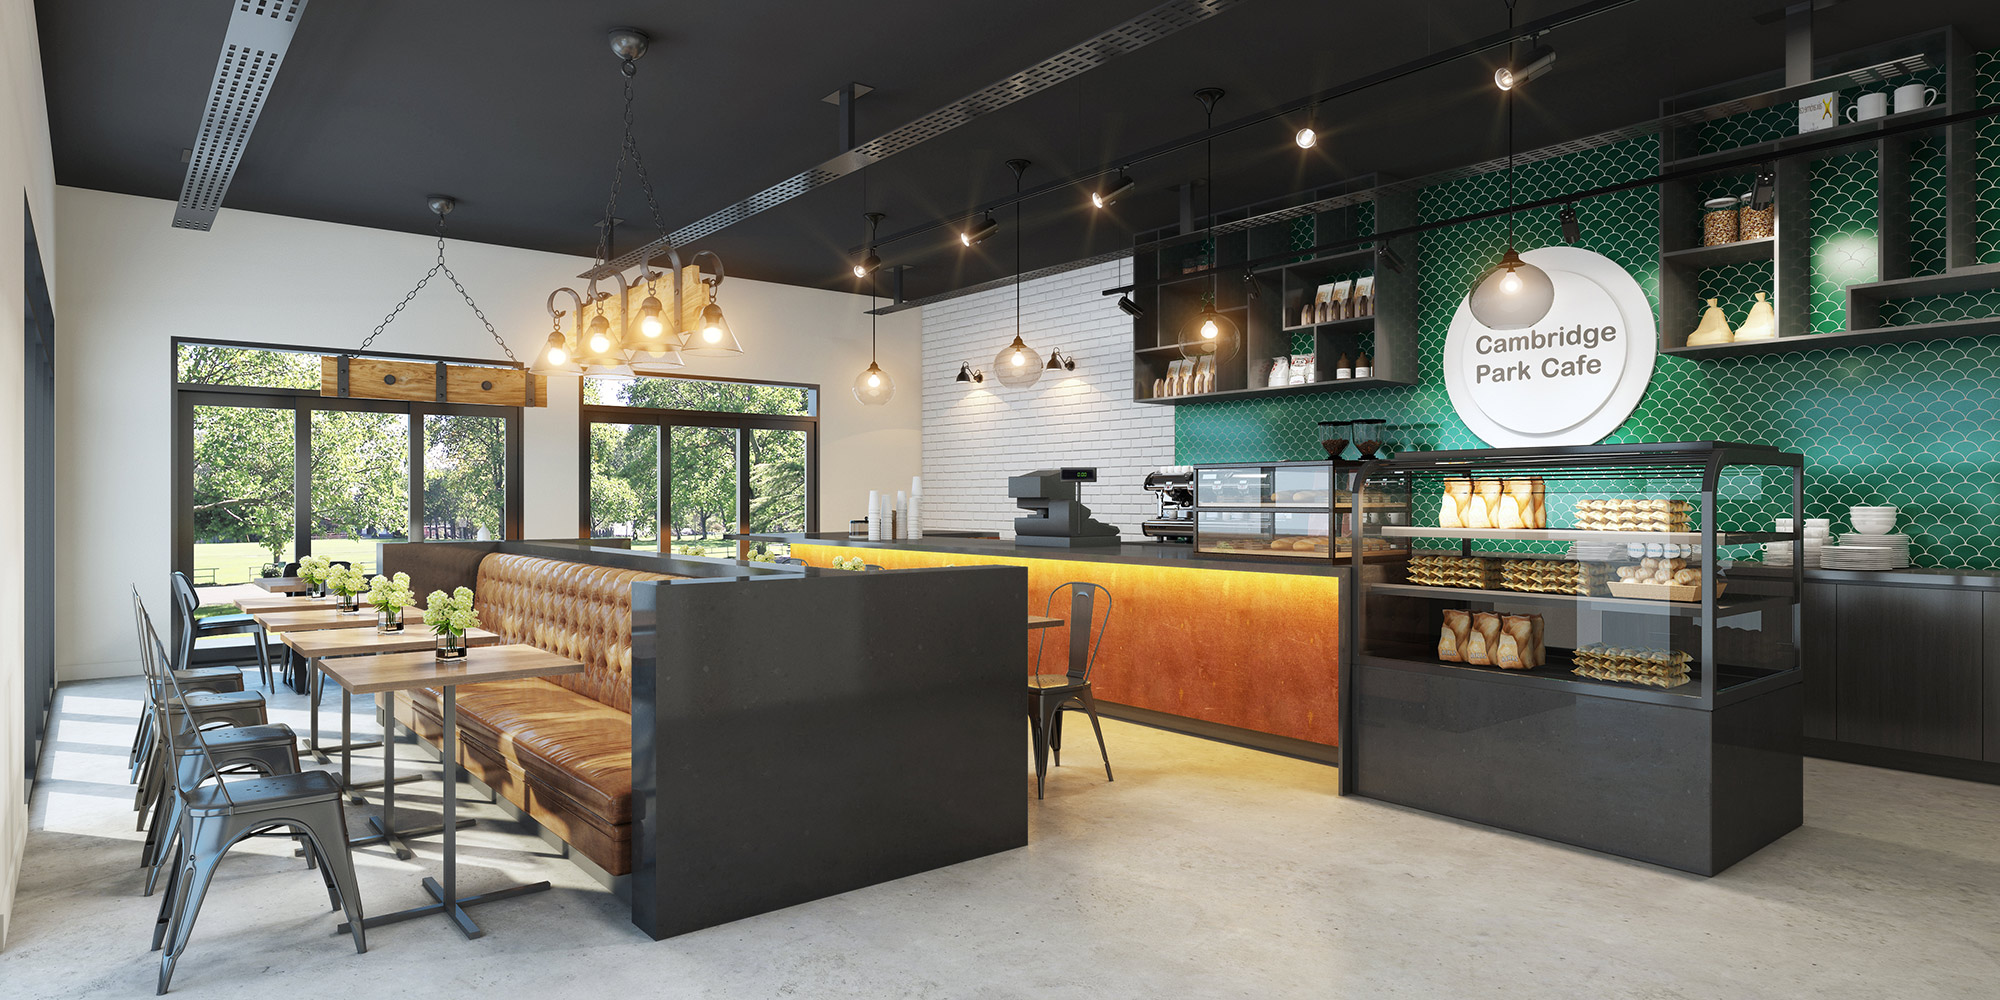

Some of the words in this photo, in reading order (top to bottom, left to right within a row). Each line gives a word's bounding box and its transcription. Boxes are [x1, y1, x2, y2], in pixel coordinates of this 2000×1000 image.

[1475, 324, 1616, 355] Cambridge
[1476, 361, 1531, 384] Park
[1541, 355, 1602, 378] Cafe
